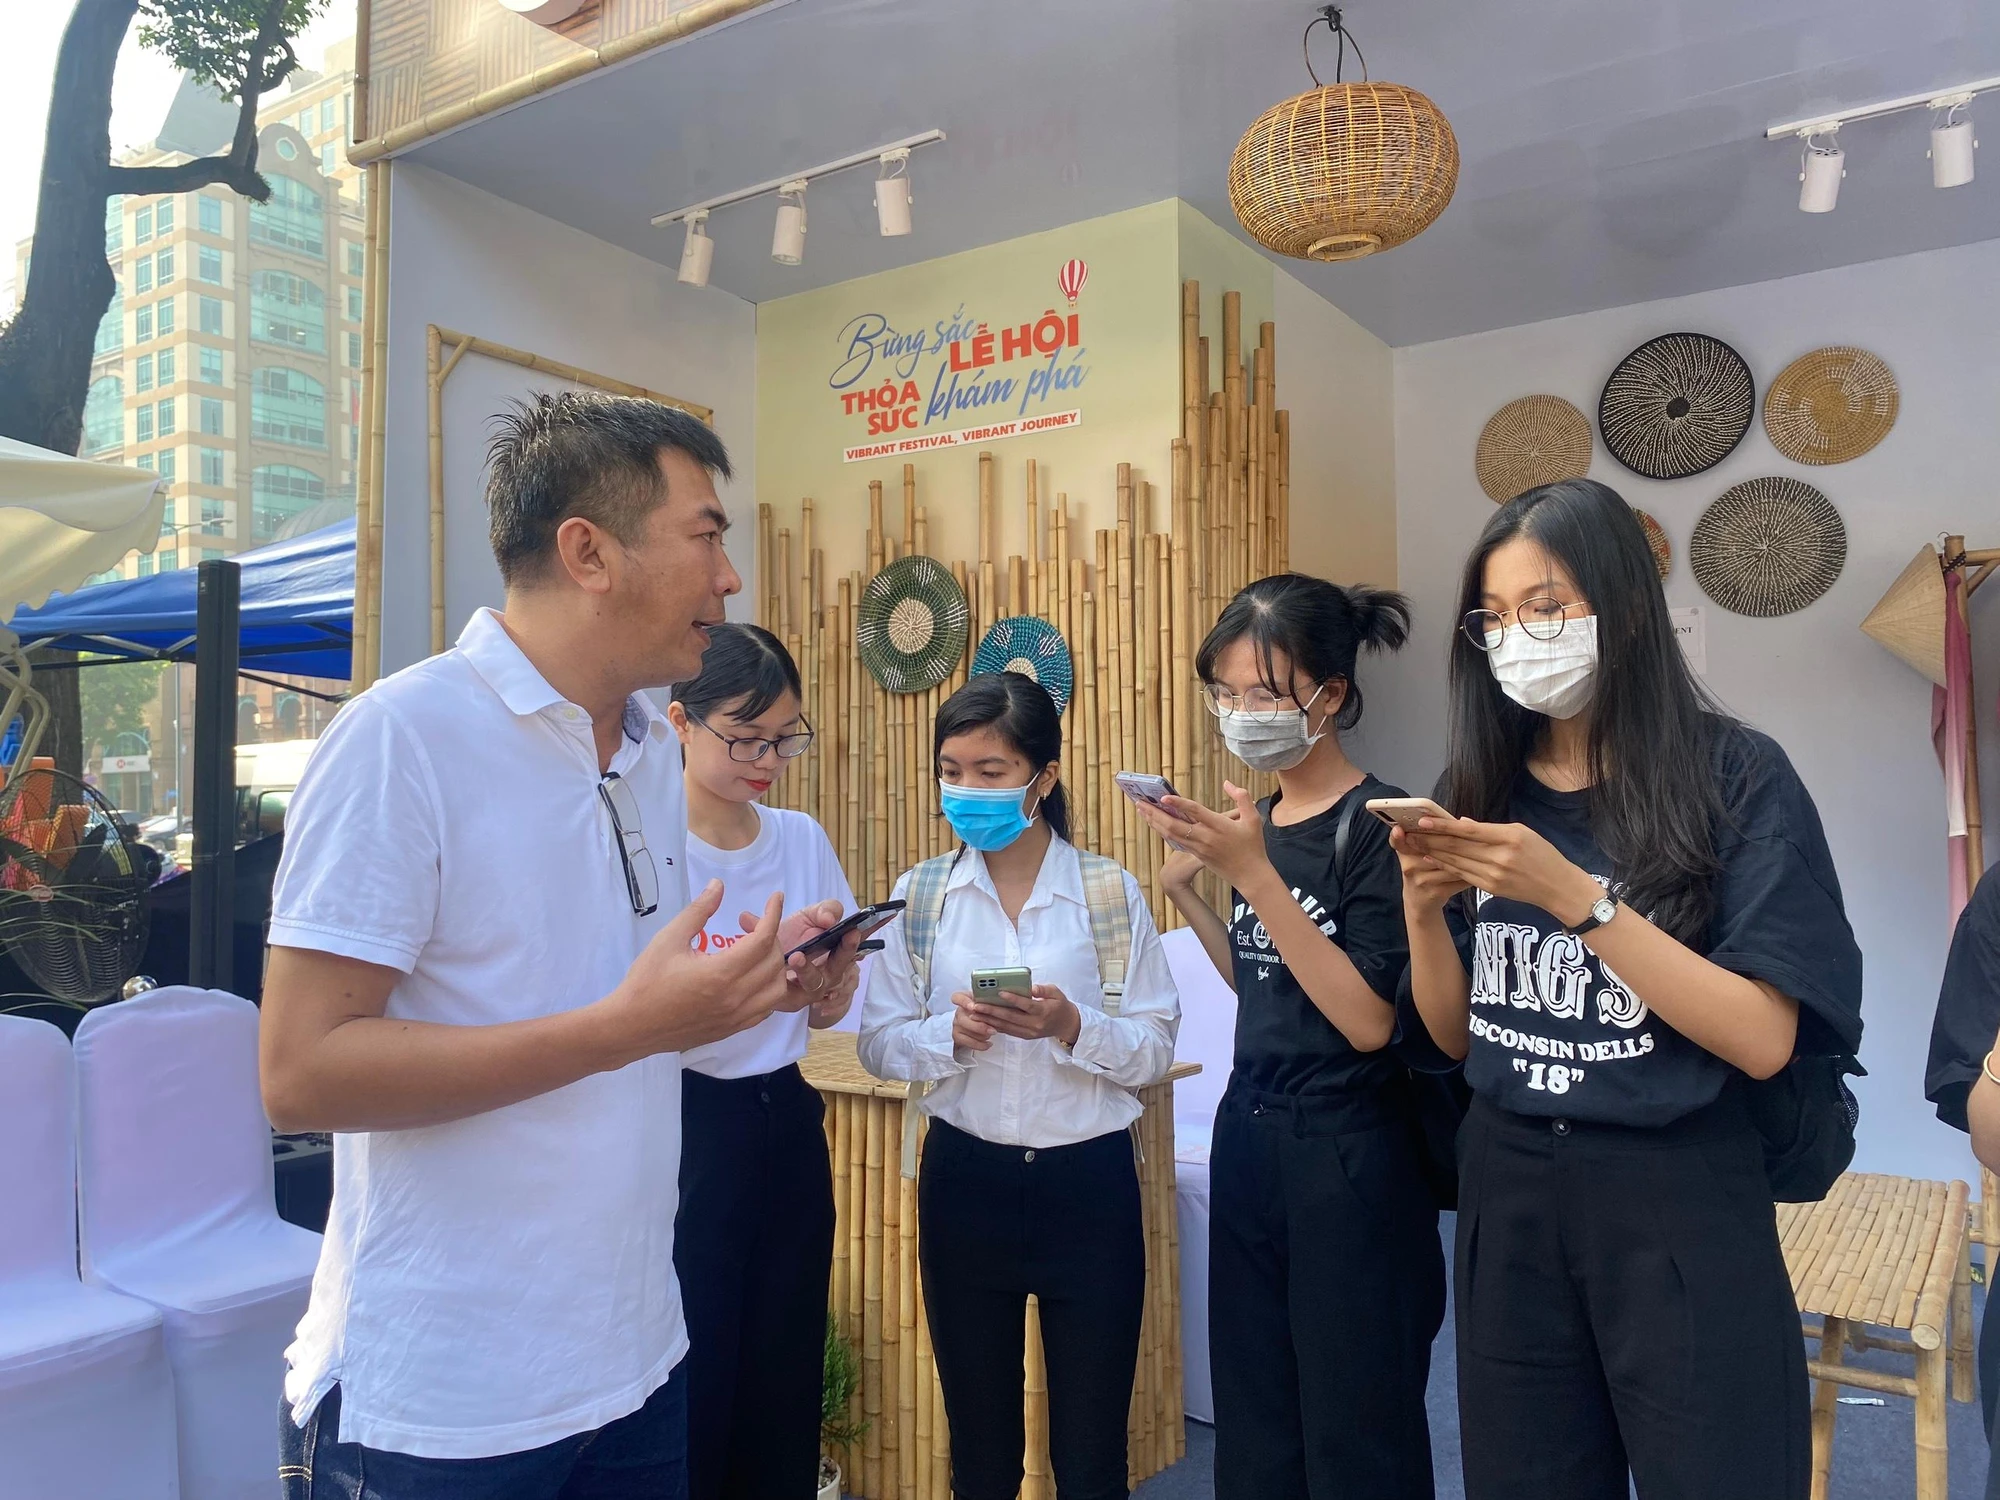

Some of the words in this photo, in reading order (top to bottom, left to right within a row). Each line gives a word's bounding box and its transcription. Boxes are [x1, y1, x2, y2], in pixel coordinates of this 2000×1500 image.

[829, 313, 926, 389] Bừng
[930, 303, 977, 355] sắc
[950, 323, 994, 373] LỄ
[1001, 309, 1079, 359] HỘI
[841, 379, 921, 415] THỎA
[924, 360, 1019, 426] khám
[1019, 345, 1092, 416] phá
[846, 444, 896, 460] VIBRANT
[899, 434, 958, 452] FESTIVAL,
[962, 424, 1017, 441] VIBRANT
[1020, 412, 1078, 432] JOURNEY
[868, 404, 918, 436] SỨC
[1237, 930, 1252, 946] Est.
[1238, 950, 1257, 961] QUALITY
[1257, 953, 1280, 964] OUTDOOR
[1469, 1009, 1576, 1060] ISCONSIN
[1577, 1032, 1655, 1062] DELLS
